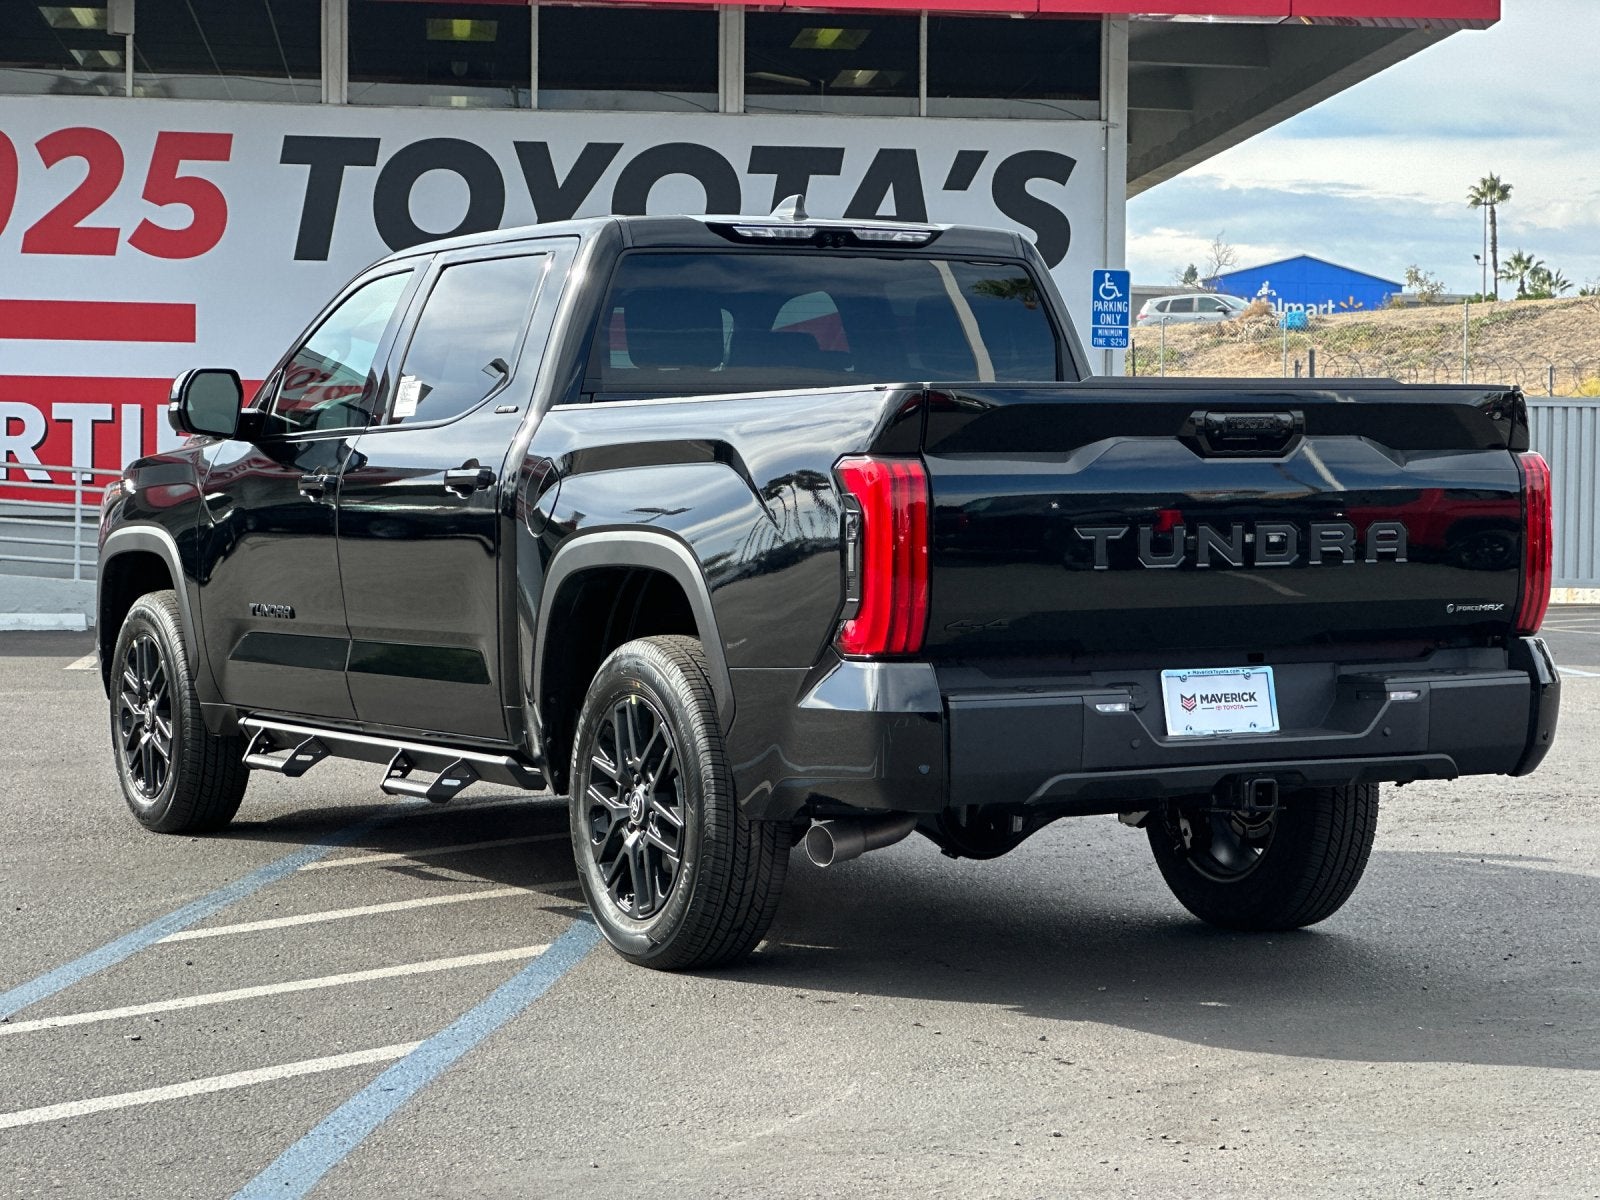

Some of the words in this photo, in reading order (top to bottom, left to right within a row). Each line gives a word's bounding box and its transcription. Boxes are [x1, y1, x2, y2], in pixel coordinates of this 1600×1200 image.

[0, 126, 233, 259] 25
[279, 134, 1077, 270] TOYOTA'S
[1093, 300, 1128, 313] PARKING
[1100, 313, 1121, 325] ONLY
[1098, 328, 1123, 337] MINIMUM
[1093, 337, 1106, 346] FINE
[1110, 337, 1127, 347] $250
[1073, 520, 1408, 570] TUNDRA
[248, 602, 296, 619] TUNDRA
[1199, 691, 1257, 705] MAVERICK
